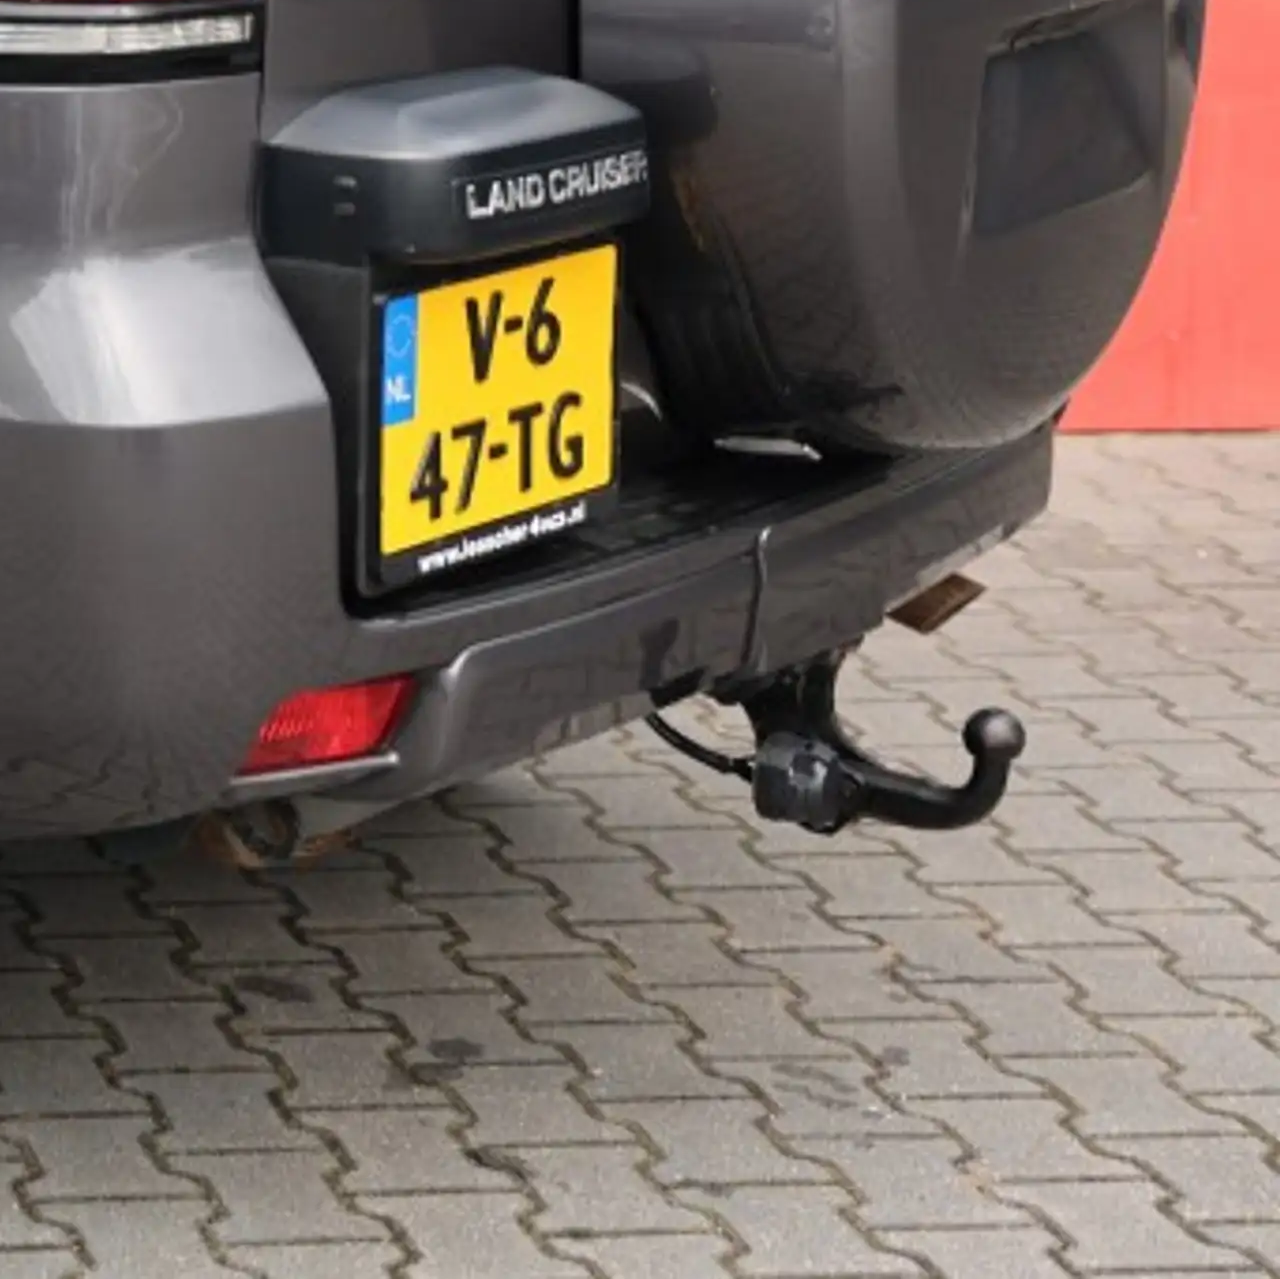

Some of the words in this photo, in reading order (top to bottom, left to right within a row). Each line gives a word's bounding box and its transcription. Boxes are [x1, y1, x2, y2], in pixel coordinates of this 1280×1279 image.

[465, 174, 546, 219] LAND
[548, 150, 648, 203] CRUISER
[465, 277, 561, 384] V-6
[386, 375, 412, 404] NL
[409, 391, 584, 521] 47-TG
